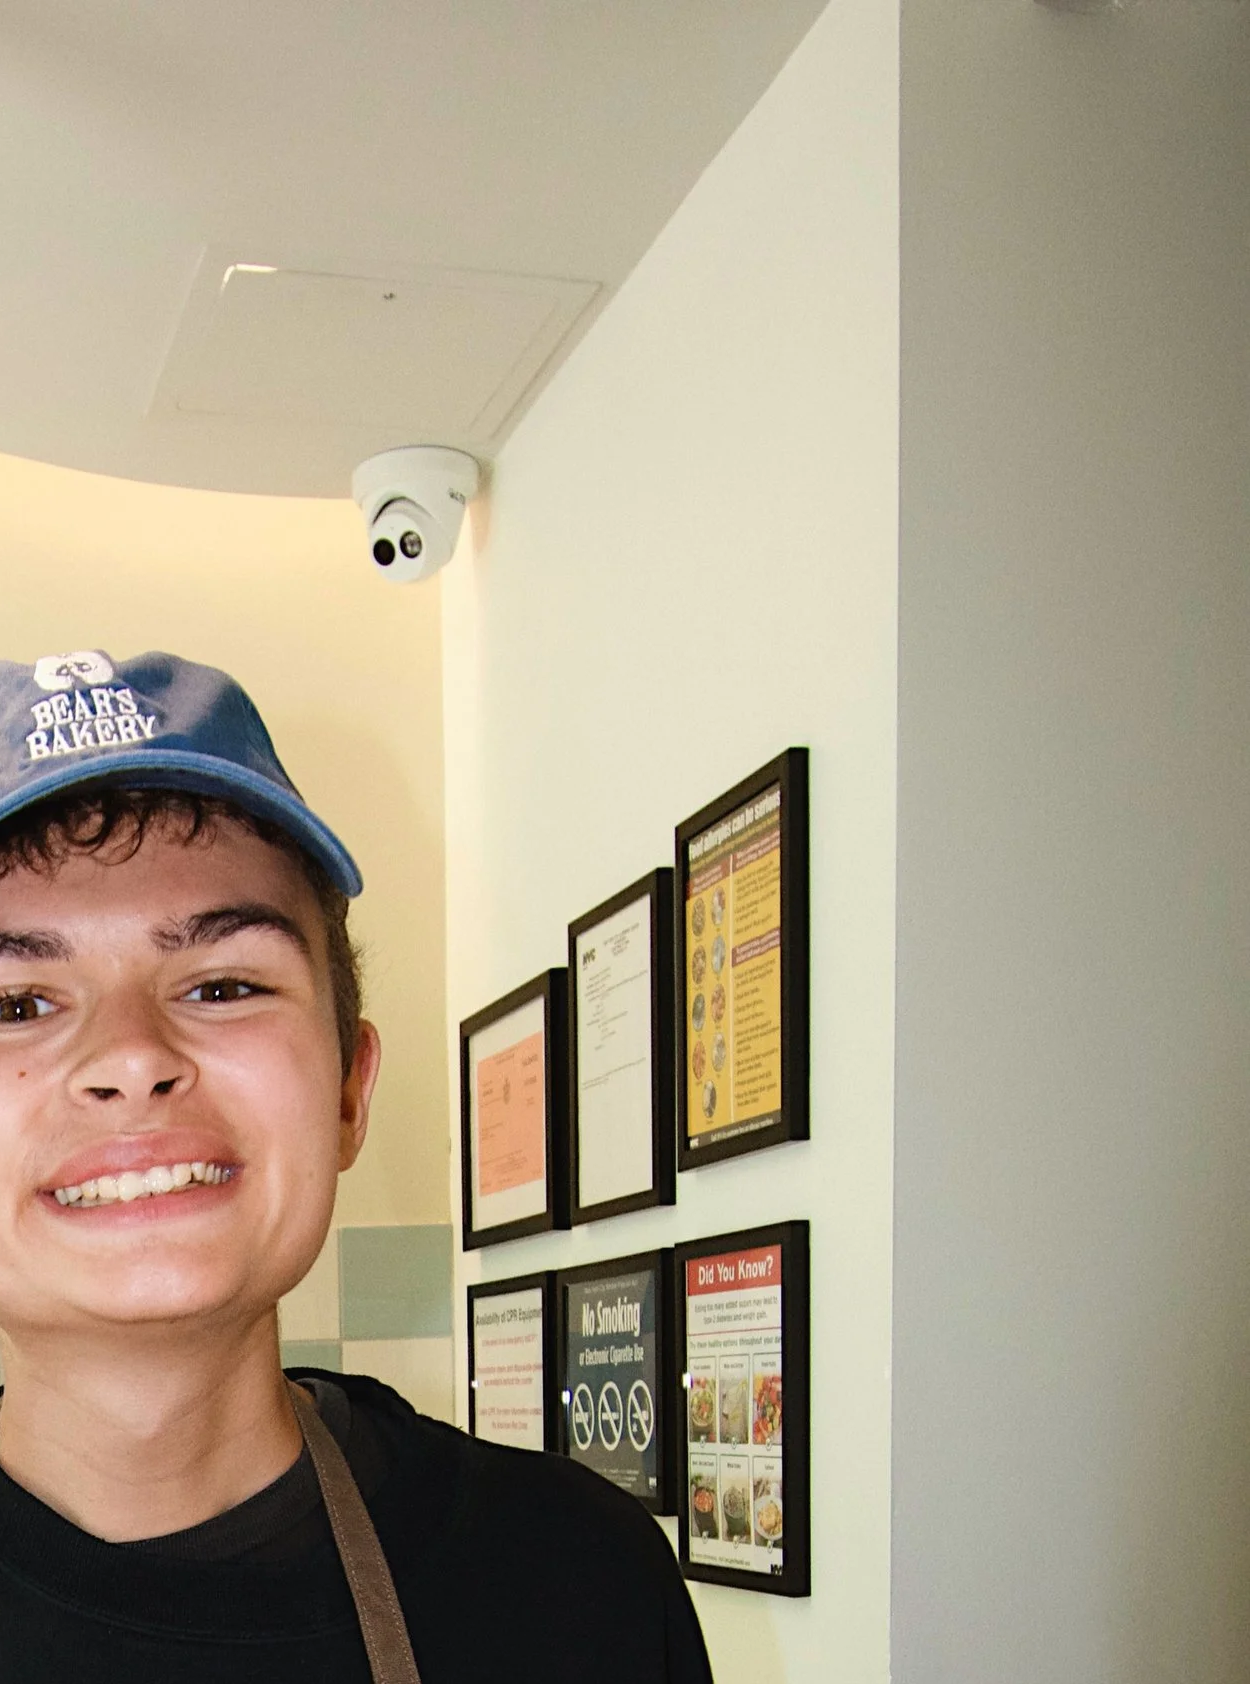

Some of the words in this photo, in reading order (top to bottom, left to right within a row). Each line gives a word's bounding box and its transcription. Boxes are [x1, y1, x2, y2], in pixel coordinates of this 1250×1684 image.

[30, 687, 138, 731] BEAR'S
[25, 713, 156, 760] BAKERY
[698, 1264, 714, 1286] Did
[717, 1262, 735, 1283] You
[738, 1254, 774, 1280] Know?
[582, 1302, 595, 1337] No
[597, 1296, 640, 1337] Smoking
[585, 1346, 609, 1366] Electronic
[610, 1345, 633, 1367] Cigarette
